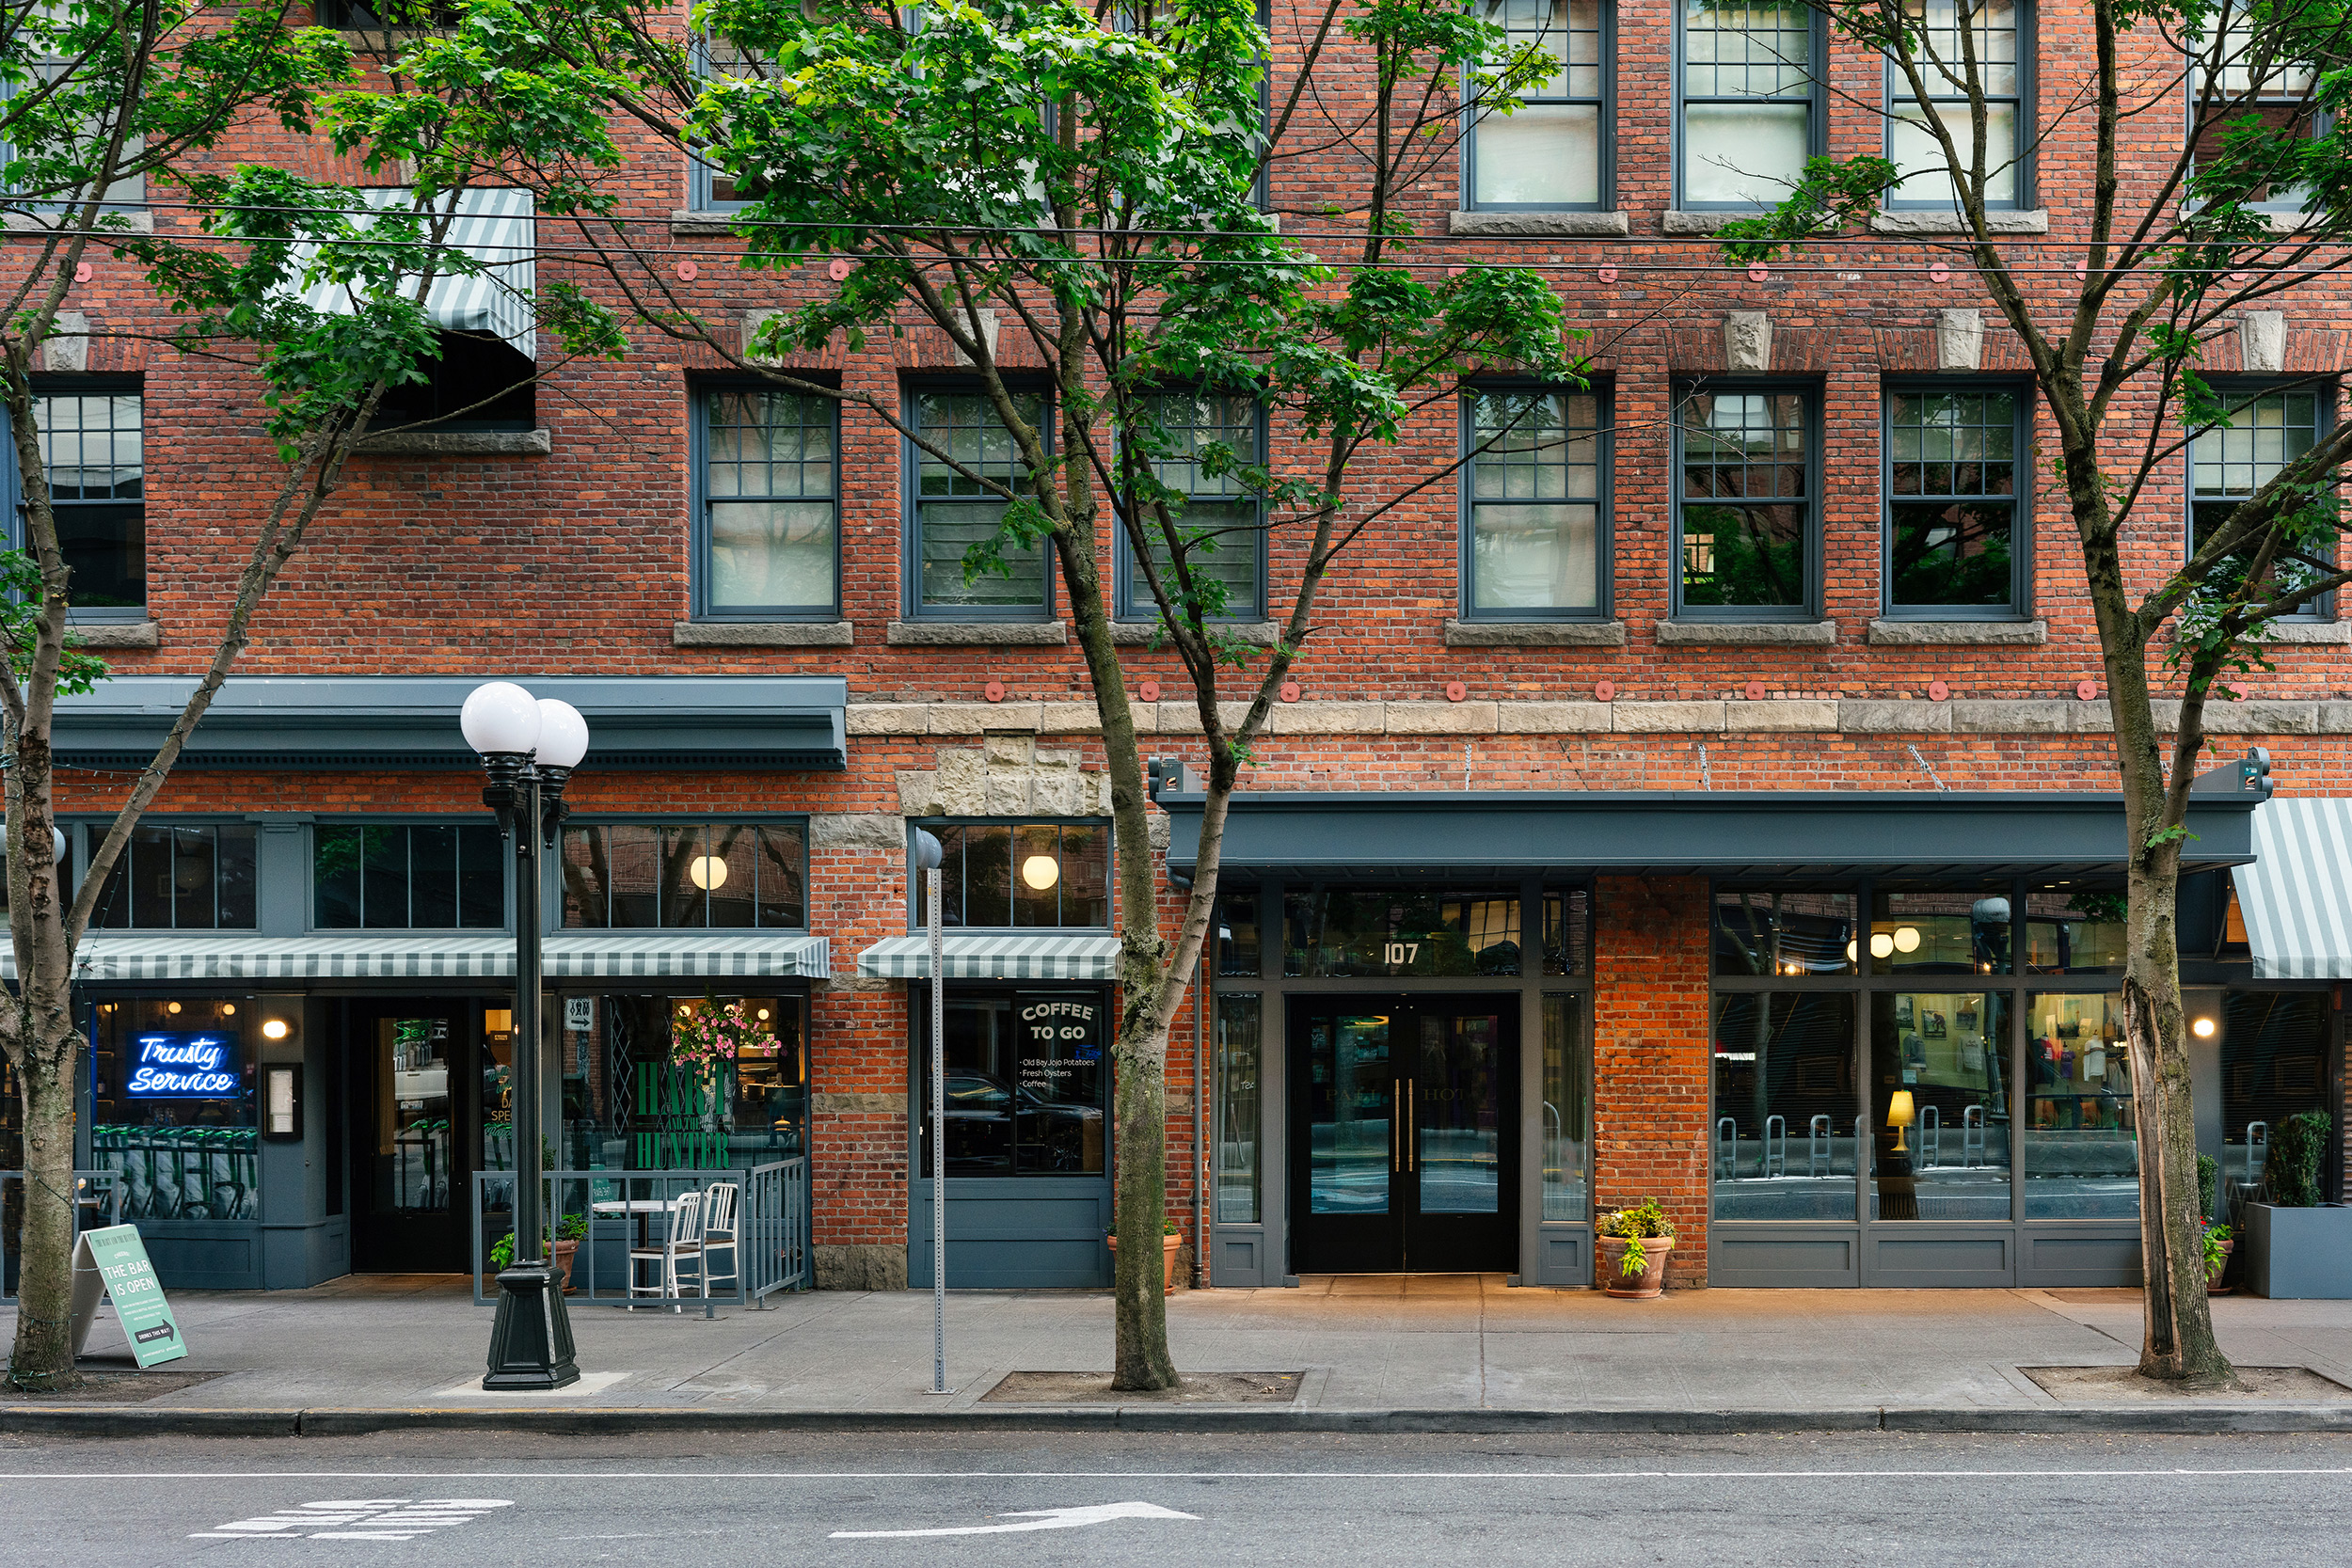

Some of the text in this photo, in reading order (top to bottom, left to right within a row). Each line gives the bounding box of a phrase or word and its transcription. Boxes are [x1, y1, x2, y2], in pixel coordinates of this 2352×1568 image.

[1385, 943, 1419, 963] 107
[1022, 1002, 1094, 1021] COFFEE
[1030, 1026, 1086, 1039] TO GO
[139, 1037, 220, 1070] Trusty
[1023, 1058, 1035, 1067] Old
[1036, 1058, 1047, 1068] Bay
[1047, 1059, 1062, 1068] Jojo
[128, 1067, 233, 1091] Service
[1044, 1069, 1073, 1079] Oysters
[636, 1061, 732, 1116] HART
[1023, 1080, 1047, 1088] Coffee
[668, 1117, 701, 1131] AND THE
[636, 1132, 732, 1169] HUNTER
[104, 1259, 151, 1280] THE BAR
[114, 1276, 155, 1297] IS OPEN
[138, 1332, 152, 1340] DRINKS
